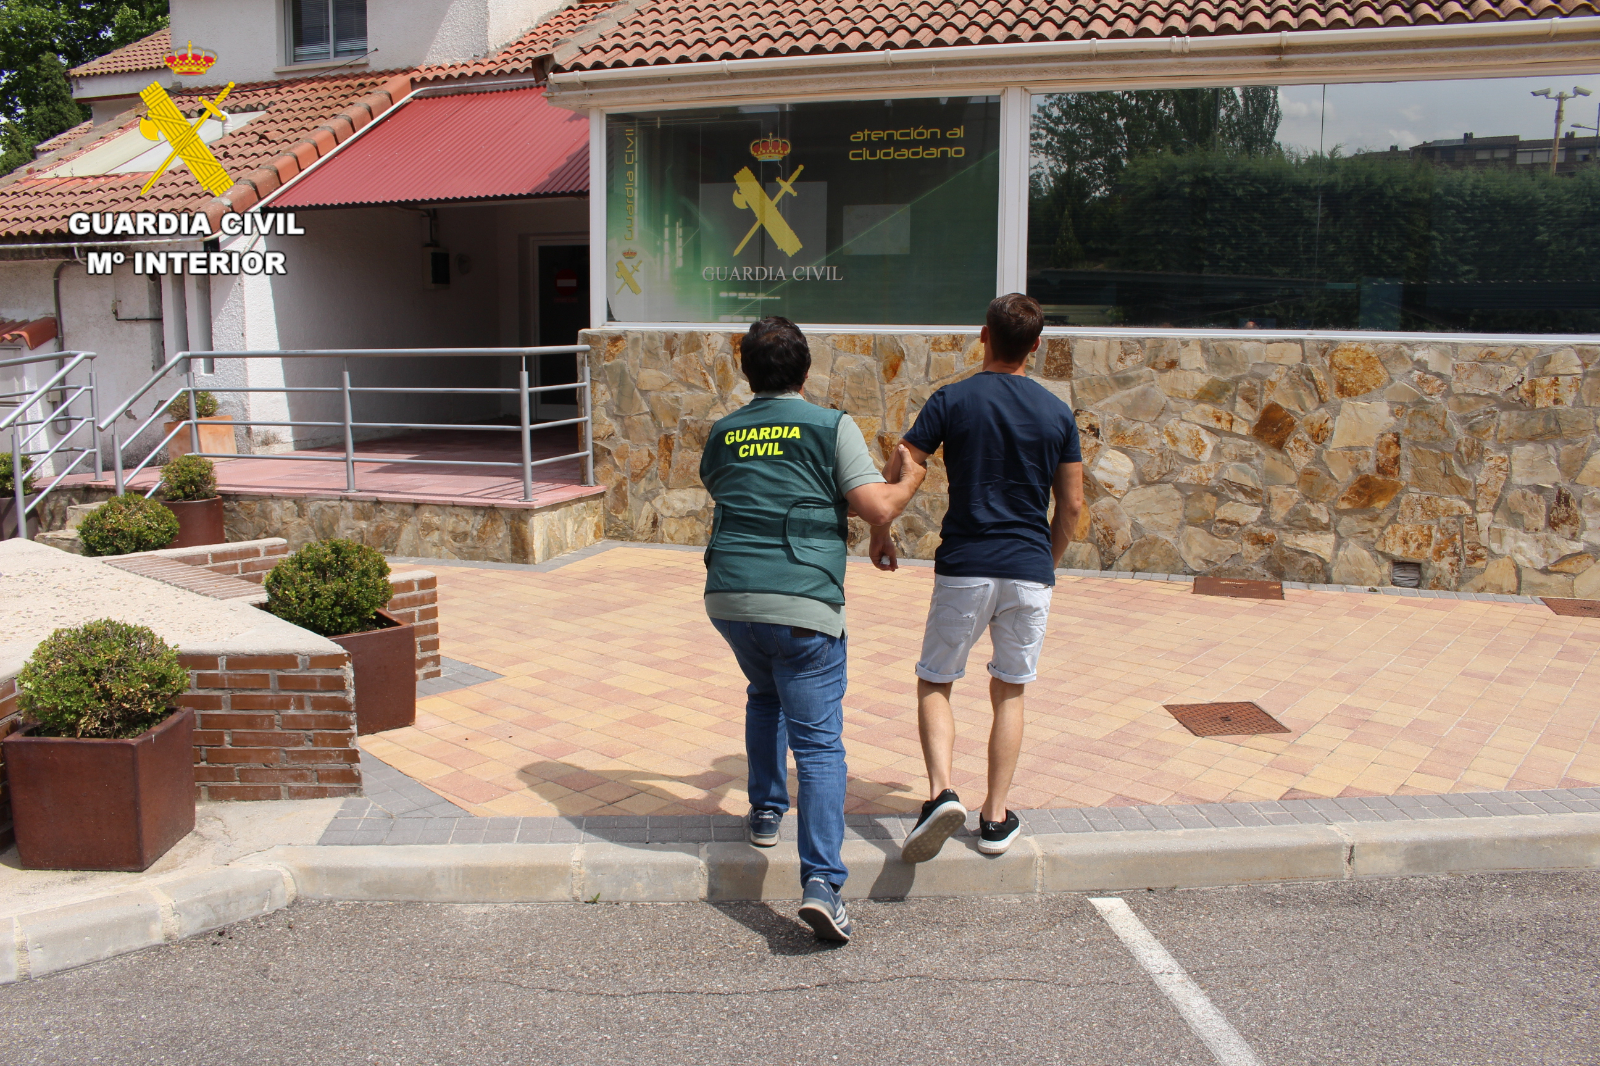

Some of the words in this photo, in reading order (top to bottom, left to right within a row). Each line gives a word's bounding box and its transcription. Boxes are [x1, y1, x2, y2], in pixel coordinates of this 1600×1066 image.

[850, 125, 941, 142] atención
[946, 125, 964, 138] al
[624, 128, 634, 165] Civil
[849, 145, 965, 160] ciudadano
[702, 266, 787, 281] GUARDIA
[792, 266, 844, 281] CIVIL
[724, 426, 801, 445] GUARDIA
[738, 442, 784, 458] CIVIL
